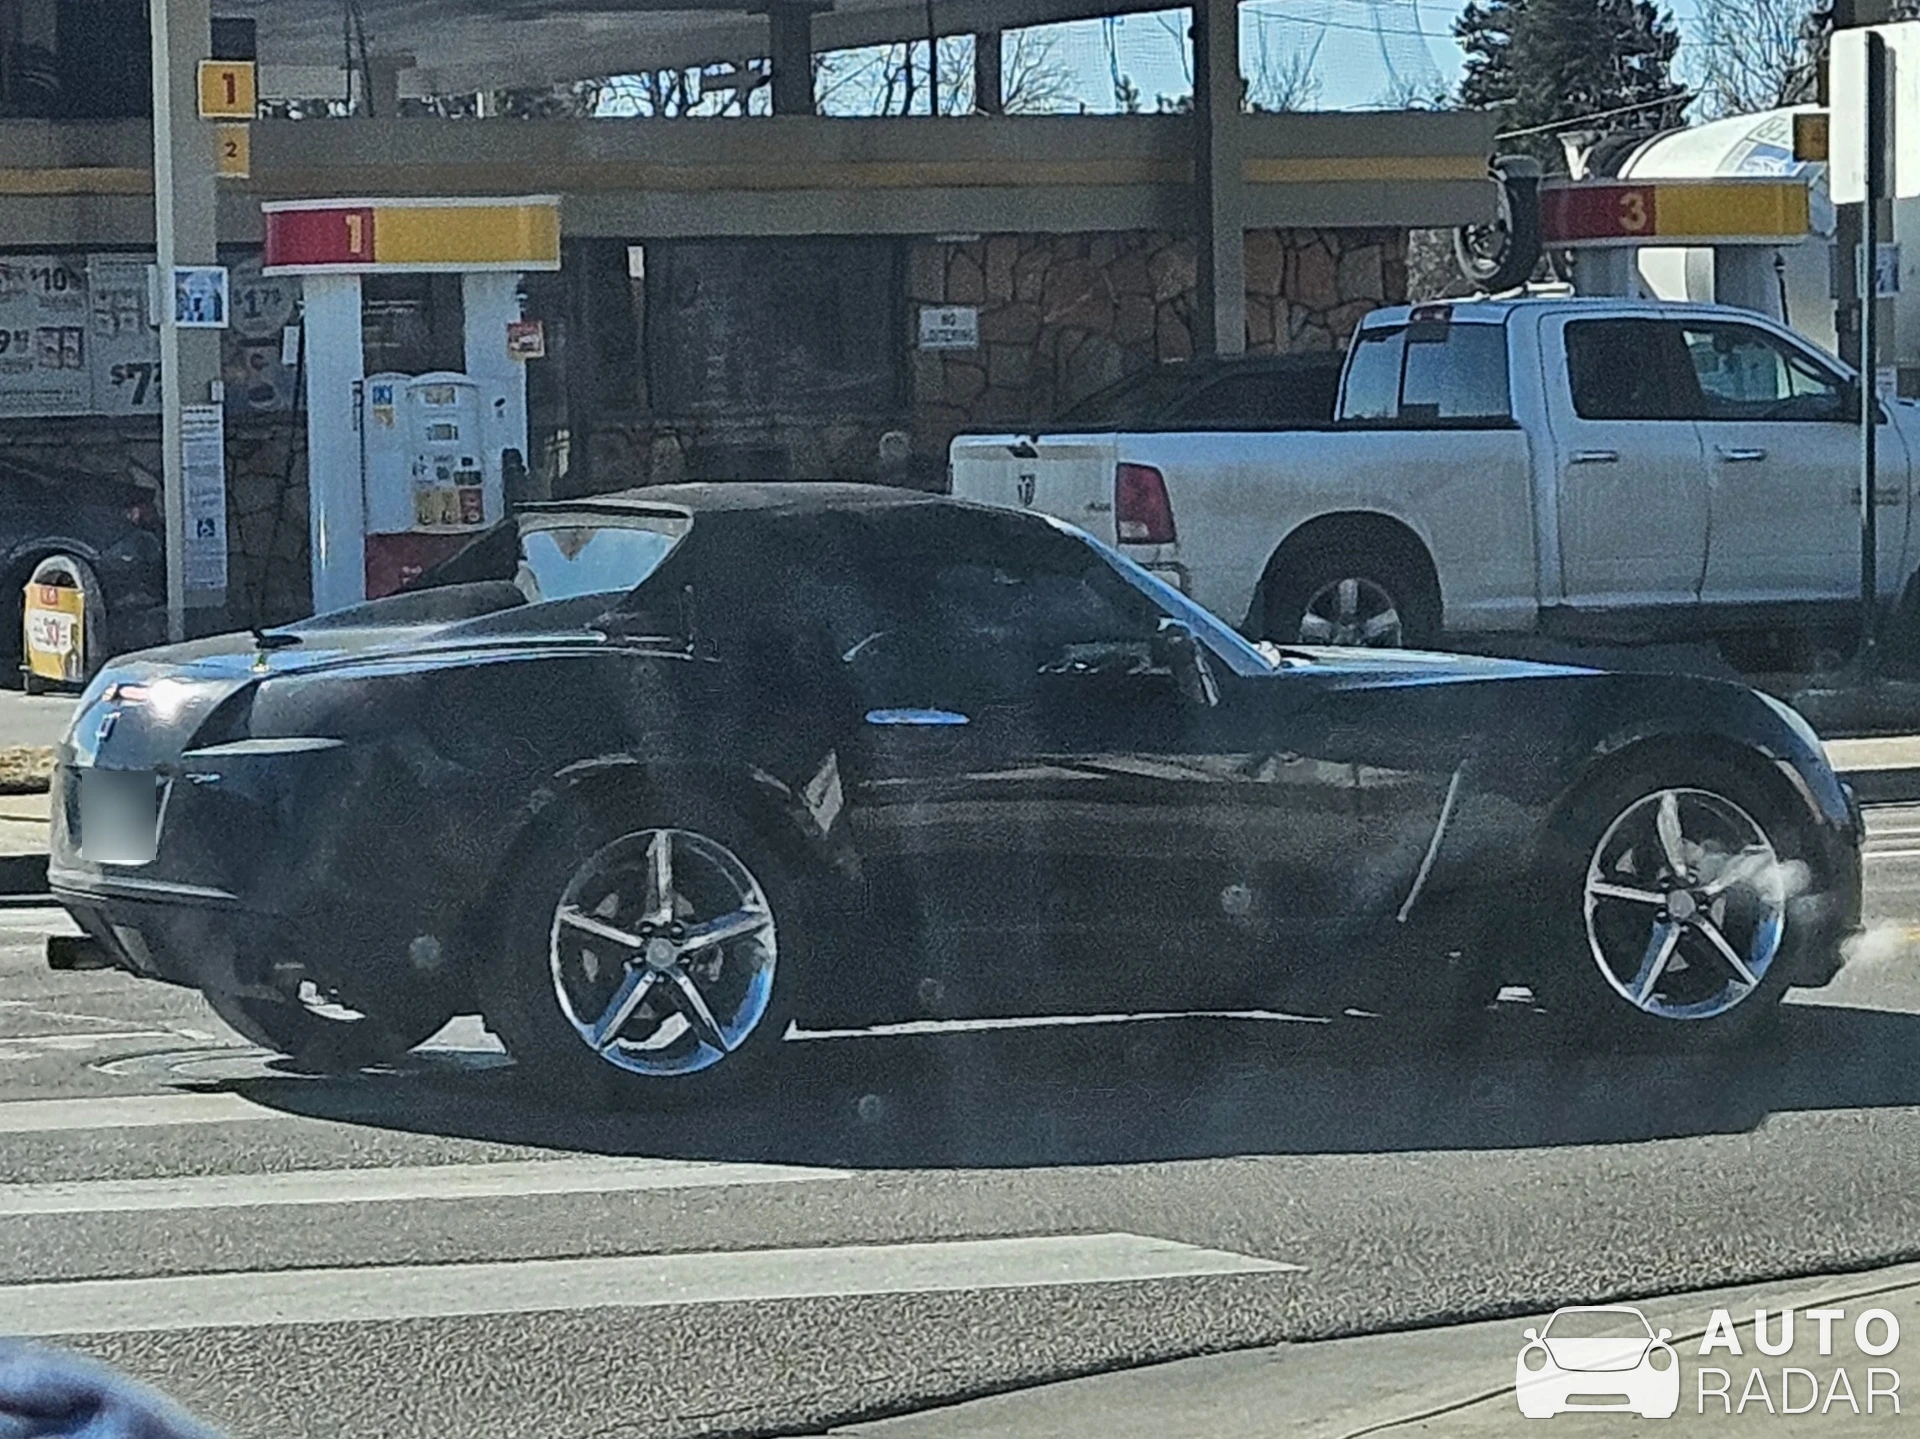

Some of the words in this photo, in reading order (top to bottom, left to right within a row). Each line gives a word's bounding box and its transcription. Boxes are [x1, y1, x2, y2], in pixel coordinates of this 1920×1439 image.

[222, 72, 236, 104] 1
[224, 142, 237, 157] 2
[1619, 192, 1647, 230] 3
[345, 214, 362, 253] 1
